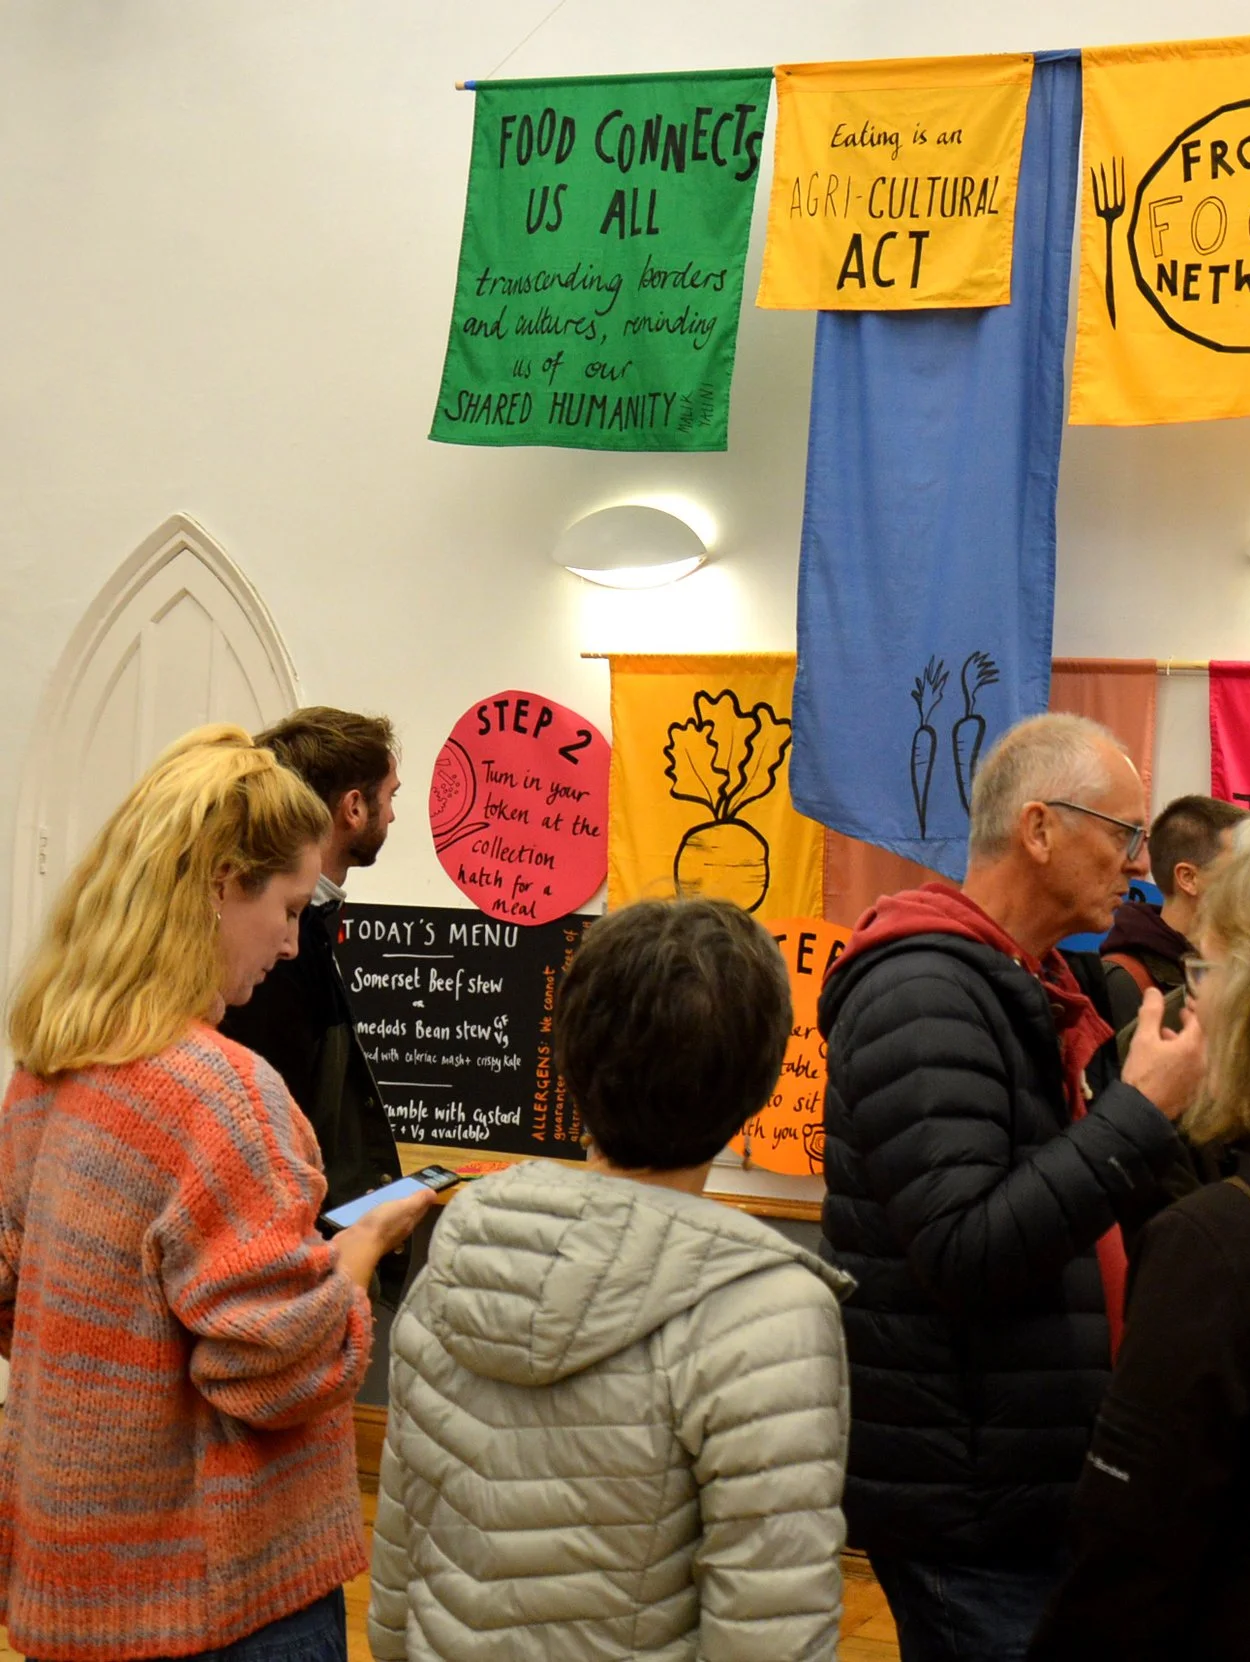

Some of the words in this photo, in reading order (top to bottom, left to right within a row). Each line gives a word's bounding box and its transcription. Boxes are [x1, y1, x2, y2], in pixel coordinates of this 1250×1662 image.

[500, 107, 576, 169] FOOD
[594, 103, 764, 182] CONNECTS
[830, 120, 902, 161] Eating
[912, 122, 928, 145] is
[936, 128, 963, 145] an
[526, 183, 568, 235] US
[600, 187, 659, 240] ALL
[789, 170, 1000, 219] AGRI-CULTURAL
[836, 230, 930, 291] ACT
[475, 262, 623, 316] transcending
[638, 254, 727, 291] borders
[463, 305, 507, 341] and
[514, 305, 607, 346] cultures,
[623, 305, 717, 350] reminding
[512, 358, 532, 379] us
[542, 350, 565, 385] of
[584, 360, 633, 381] our
[444, 390, 532, 425] SHARED
[548, 391, 677, 432] HUMANITY
[477, 699, 553, 739] STEP
[558, 729, 593, 765] 2
[481, 760, 516, 788] Turn
[523, 769, 543, 791] in
[546, 781, 590, 805] your
[483, 792, 529, 824] token
[541, 815, 561, 831] at
[572, 813, 600, 837] the
[471, 836, 555, 870] collection
[458, 864, 503, 889] hatch
[512, 875, 534, 899] for
[543, 885, 553, 895] a
[492, 899, 537, 919] meal
[342, 919, 436, 946] TODAY'S
[449, 923, 518, 948] MENU
[562, 930, 579, 942] of
[351, 966, 421, 993] Somerset
[428, 967, 465, 1001] Beef
[467, 974, 504, 994] stew
[542, 965, 556, 1011] cannot
[415, 1019, 450, 1040] Bean
[456, 1020, 492, 1040] stew
[493, 1014, 509, 1029] GF
[493, 1031, 509, 1049] Vg
[539, 1016, 552, 1034] We
[381, 1048, 400, 1062] with
[405, 1049, 437, 1065] celeriac
[476, 1056, 501, 1073] crispy
[383, 1099, 429, 1122] rumble
[434, 1101, 466, 1123] with
[793, 1091, 821, 1113] sit
[411, 1124, 425, 1141] Vg
[772, 1127, 799, 1150] you
